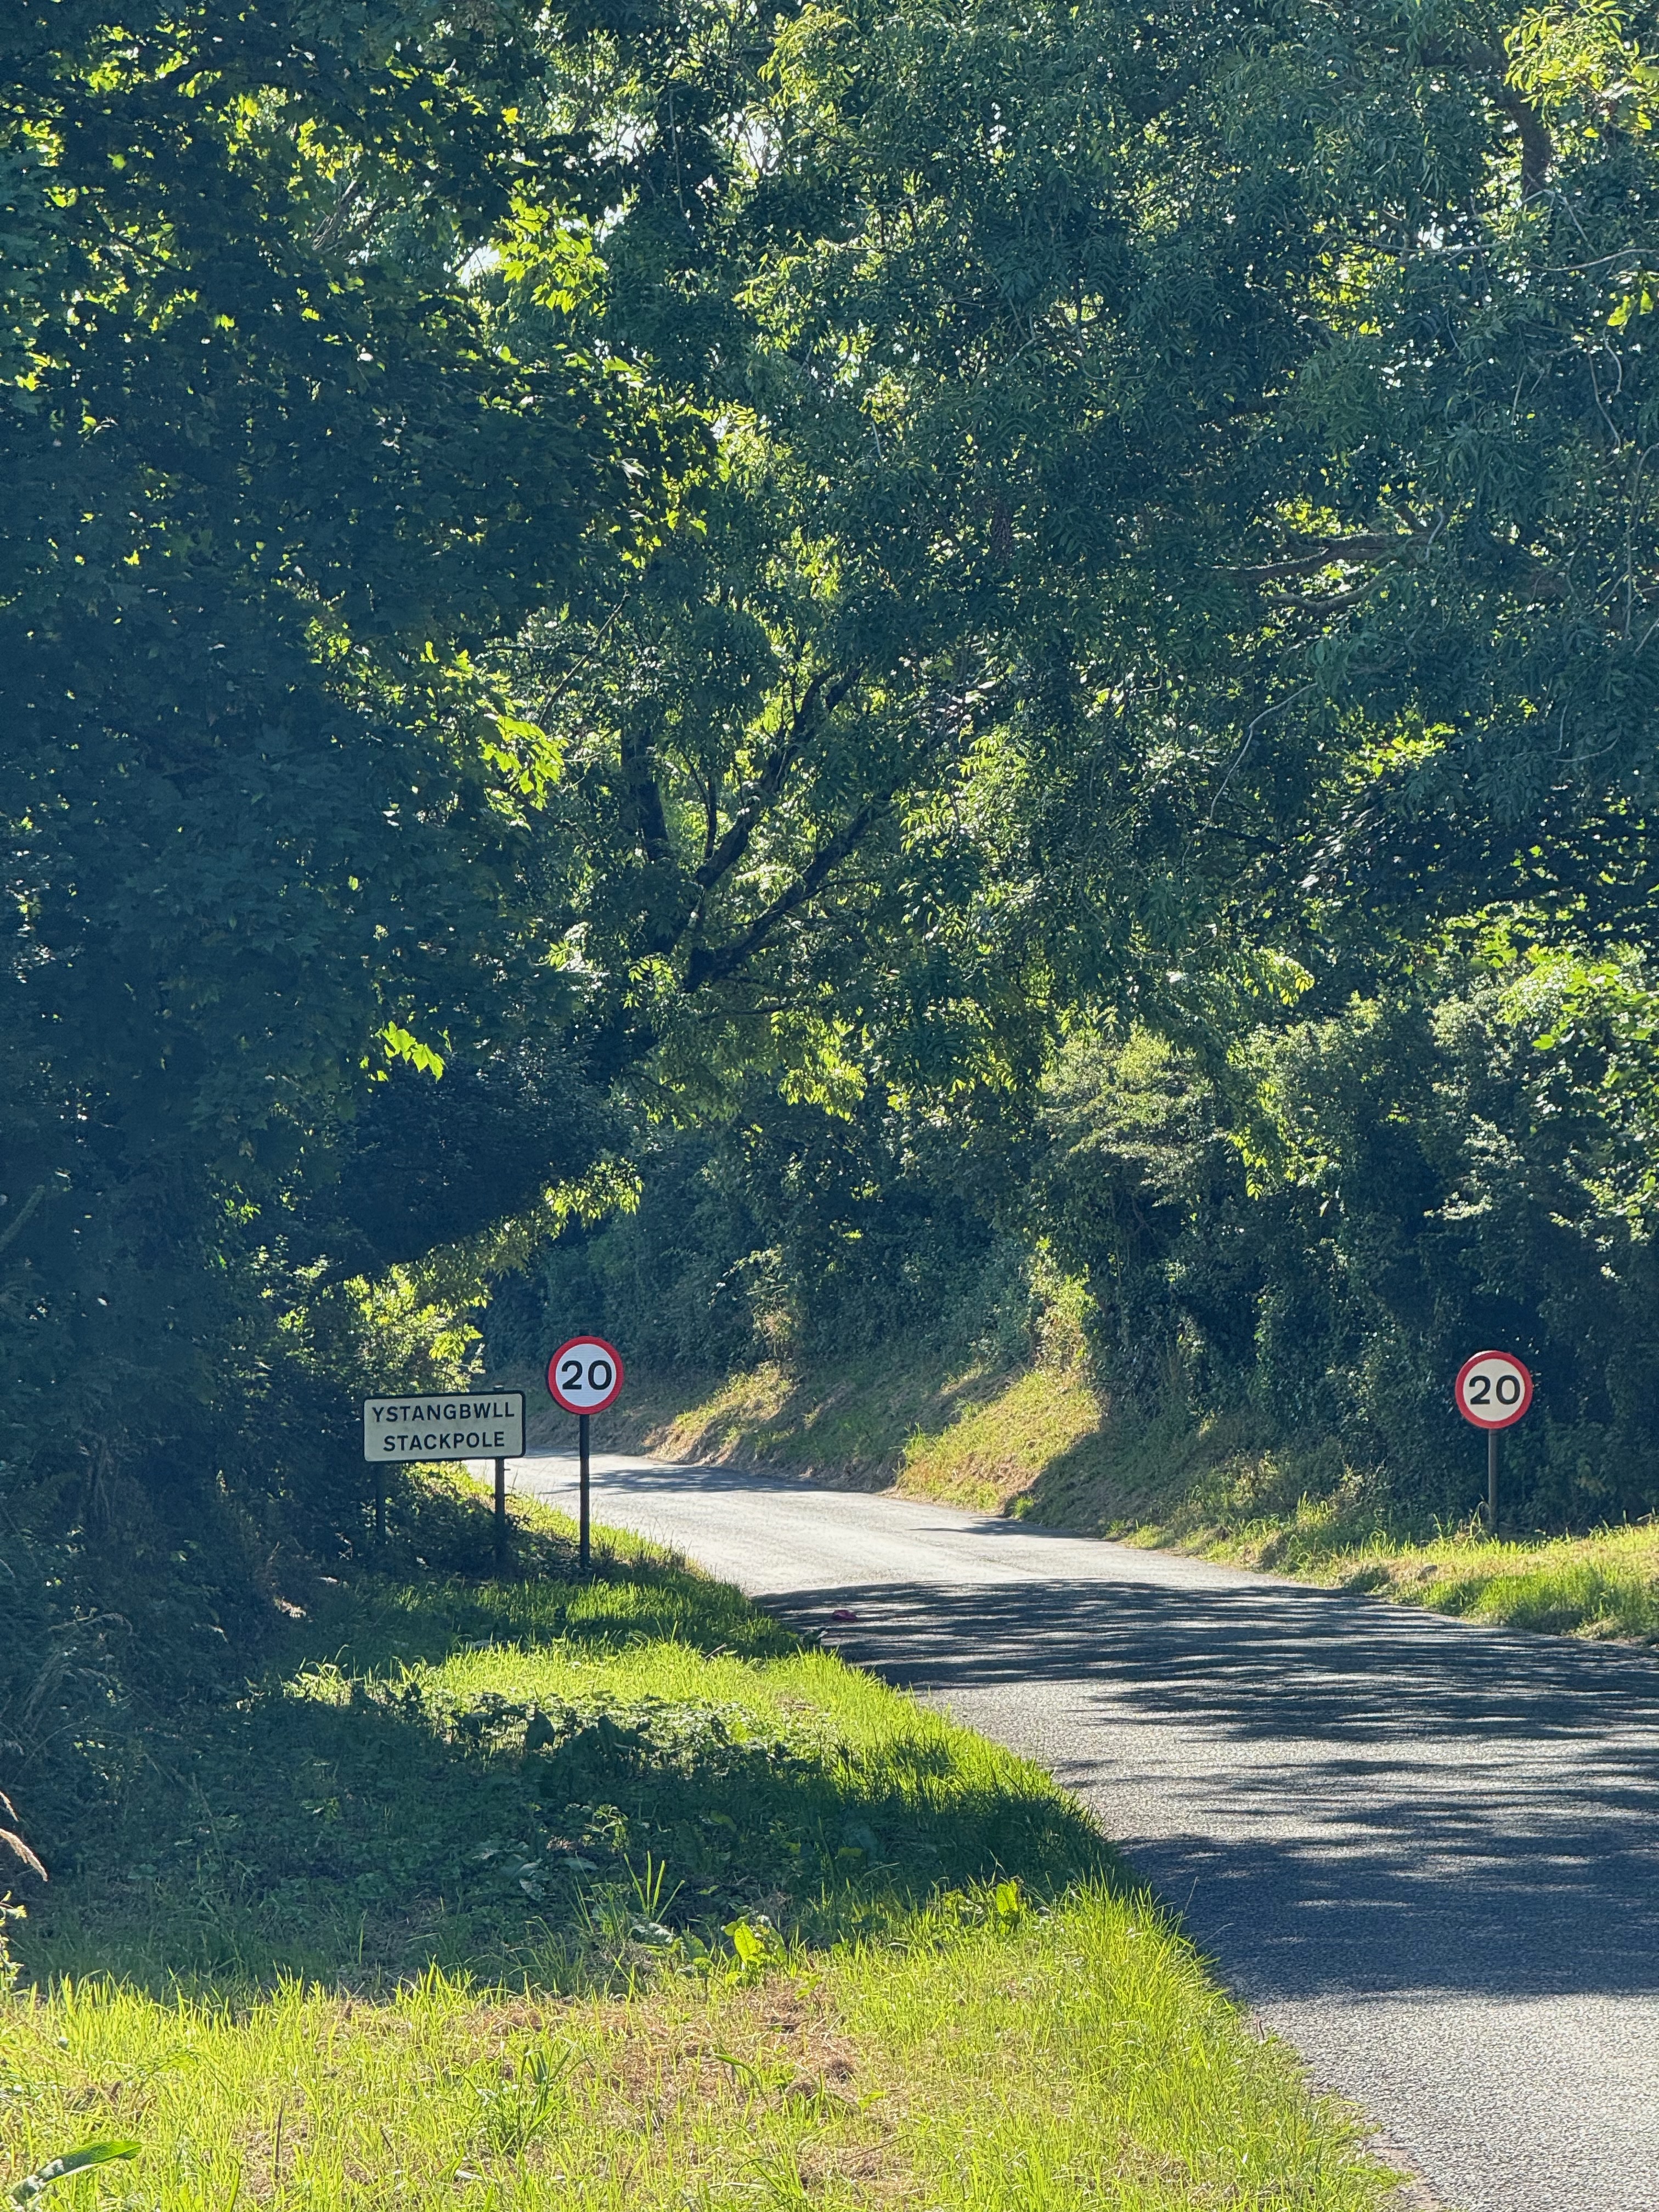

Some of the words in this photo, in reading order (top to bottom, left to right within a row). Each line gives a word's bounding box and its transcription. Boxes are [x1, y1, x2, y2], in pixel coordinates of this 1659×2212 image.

[561, 1359, 612, 1391] 20
[1469, 1374, 1521, 1406] 20
[371, 1402, 515, 1423] YSTANGBWLL
[383, 1431, 505, 1452] STACKPOLE
